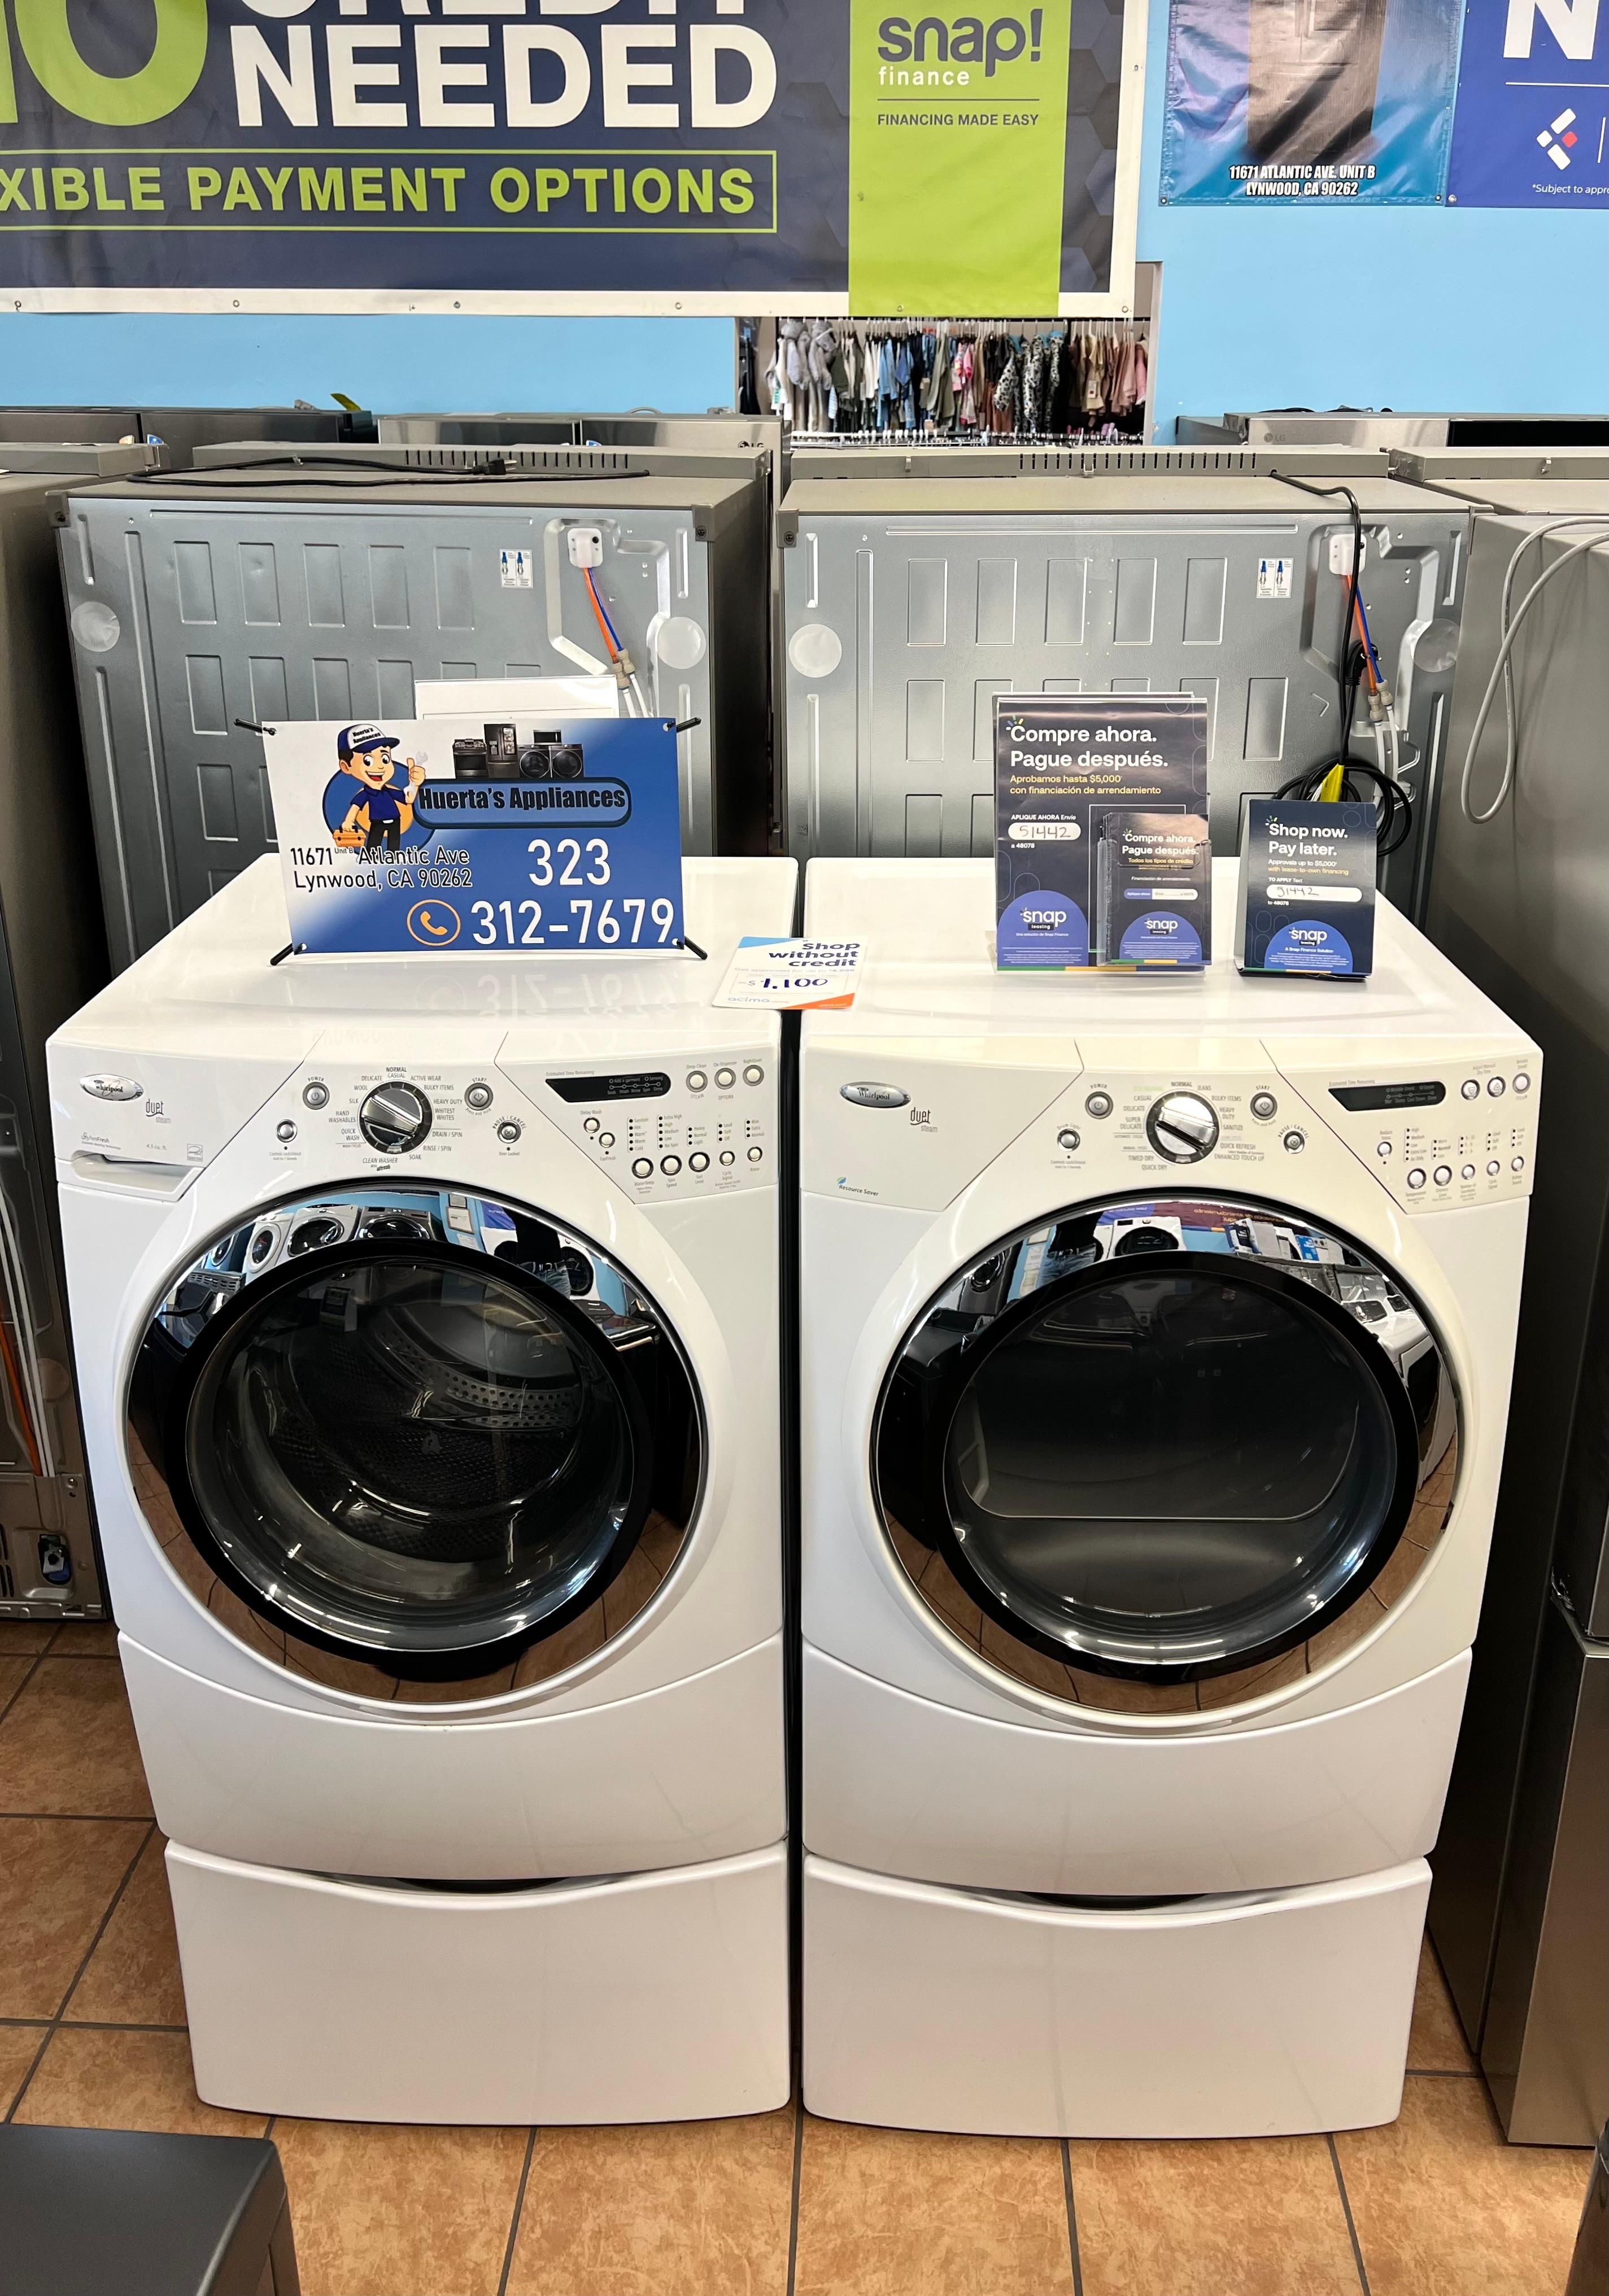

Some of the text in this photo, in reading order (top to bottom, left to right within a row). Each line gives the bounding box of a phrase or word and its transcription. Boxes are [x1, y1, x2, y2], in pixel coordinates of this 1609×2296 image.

[878, 8, 1043, 77] snap!
[230, 24, 777, 129] NEEDED
[878, 66, 970, 85] finance
[878, 114, 1039, 125] FINANCING MADE EASY
[1229, 165, 1376, 179] 11671 ATLANTIC AVE. UNIT B
[188, 167, 465, 212] PAYMENT
[490, 167, 754, 214] OPTIONS
[1246, 182, 1358, 197] LYNWOOD, CA 90262
[1573, 185, 1583, 194] to
[1010, 725, 1157, 746] Compre ahora.
[1010, 750, 1168, 771] Pague después.
[1010, 775, 1062, 784] Aprobamos
[1063, 775, 1088, 783] hasta
[1028, 785, 1083, 795] financiación
[1097, 786, 1161, 795] arrendamiento
[419, 787, 625, 810] Huerta's Appliances
[1019, 824, 1071, 839] 51442
[1124, 833, 1196, 844] Compre ahora.
[1268, 823, 1349, 839] Shop now.
[290, 847, 333, 865] 11671
[358, 846, 430, 865] Atlantic
[435, 845, 470, 865] Ave
[1122, 845, 1199, 856] Pague después.
[1268, 840, 1338, 857] Pay later.
[527, 838, 611, 886] 323
[293, 868, 473, 893] Lynwood, CA 90262
[471, 897, 674, 945] 312-7679
[1023, 910, 1067, 928] snap
[1146, 920, 1179, 933] snap
[1291, 929, 1328, 945] snap
[858, 1090, 890, 1101] Whirlpool
[146, 1098, 164, 1115] duet
[492, 1116, 505, 1129] PAUSE
[509, 1115, 527, 1130] CANCEL
[910, 1106, 931, 1124] duet
[921, 1124, 938, 1133] steam
[839, 1184, 863, 1194] Resource
